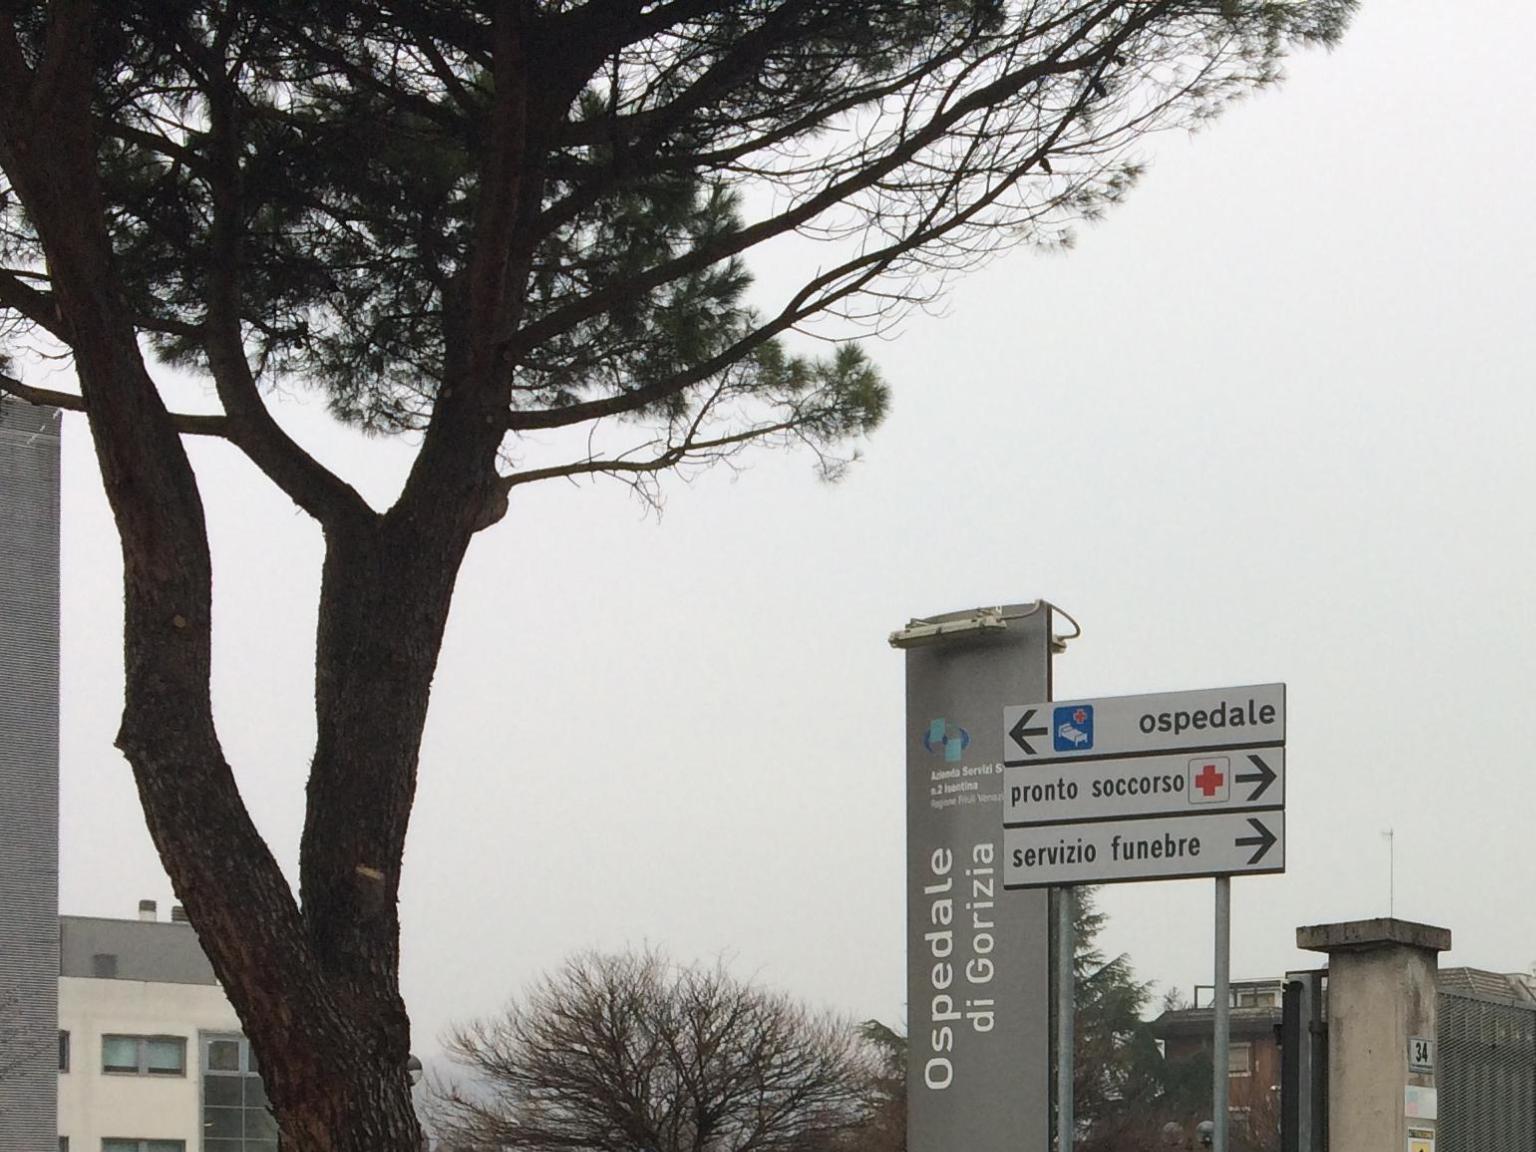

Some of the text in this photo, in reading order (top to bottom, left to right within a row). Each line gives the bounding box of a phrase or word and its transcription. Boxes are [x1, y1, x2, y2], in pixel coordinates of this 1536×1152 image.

[1139, 699, 1276, 736] ospedale
[1011, 774, 1185, 807] pronto soccorso
[1012, 832, 1201, 868] servizio funebre
[965, 842, 995, 1033] di Gorizia
[923, 847, 962, 1090] Ospedale
[1415, 1042, 1428, 1063] 34
